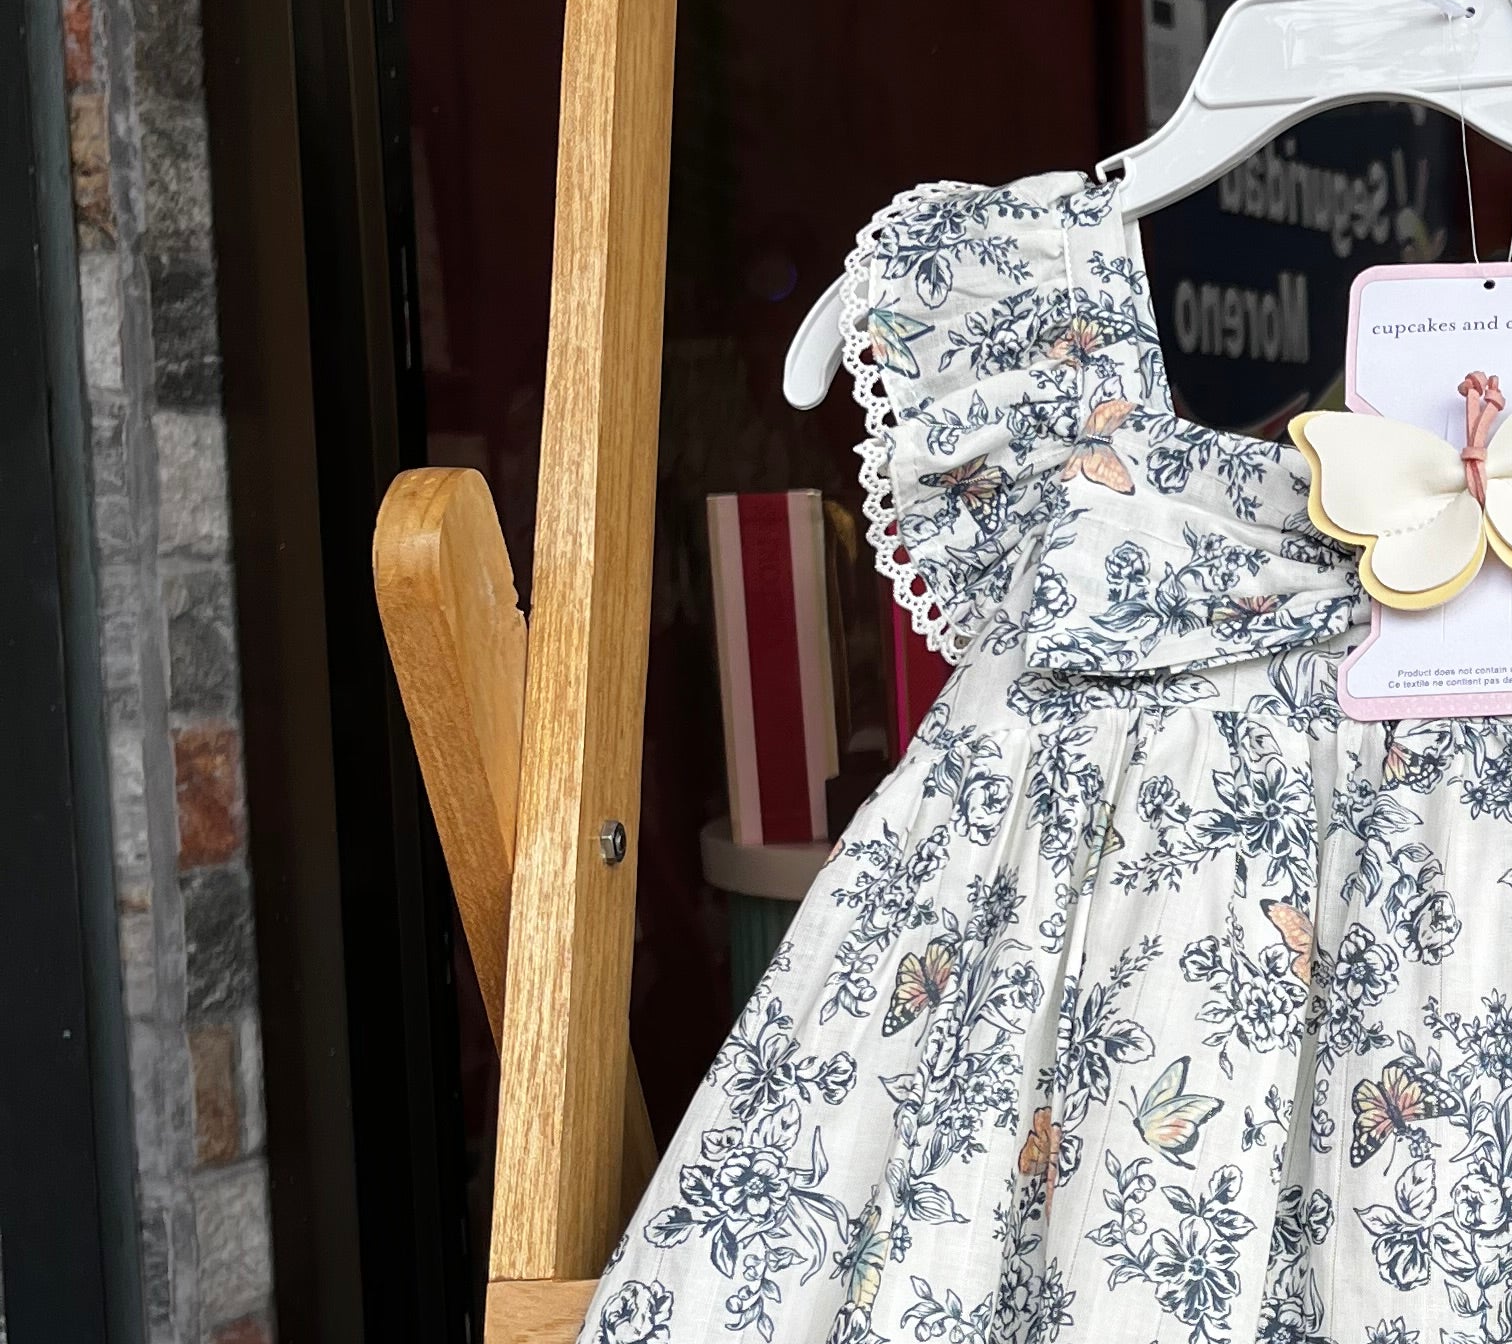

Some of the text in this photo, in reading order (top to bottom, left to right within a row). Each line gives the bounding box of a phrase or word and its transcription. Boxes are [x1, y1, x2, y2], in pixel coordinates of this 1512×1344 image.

[1371, 317, 1456, 339] cupcakes
[1462, 315, 1499, 331] and
[1397, 668, 1432, 678] Product
[1434, 668, 1456, 676] does
[1458, 667, 1473, 675] not
[1475, 666, 1507, 675] contain
[1388, 680, 1401, 689] Ce
[1403, 679, 1430, 688] textile
[1446, 677, 1482, 687] contient
[1484, 677, 1500, 687] pas
